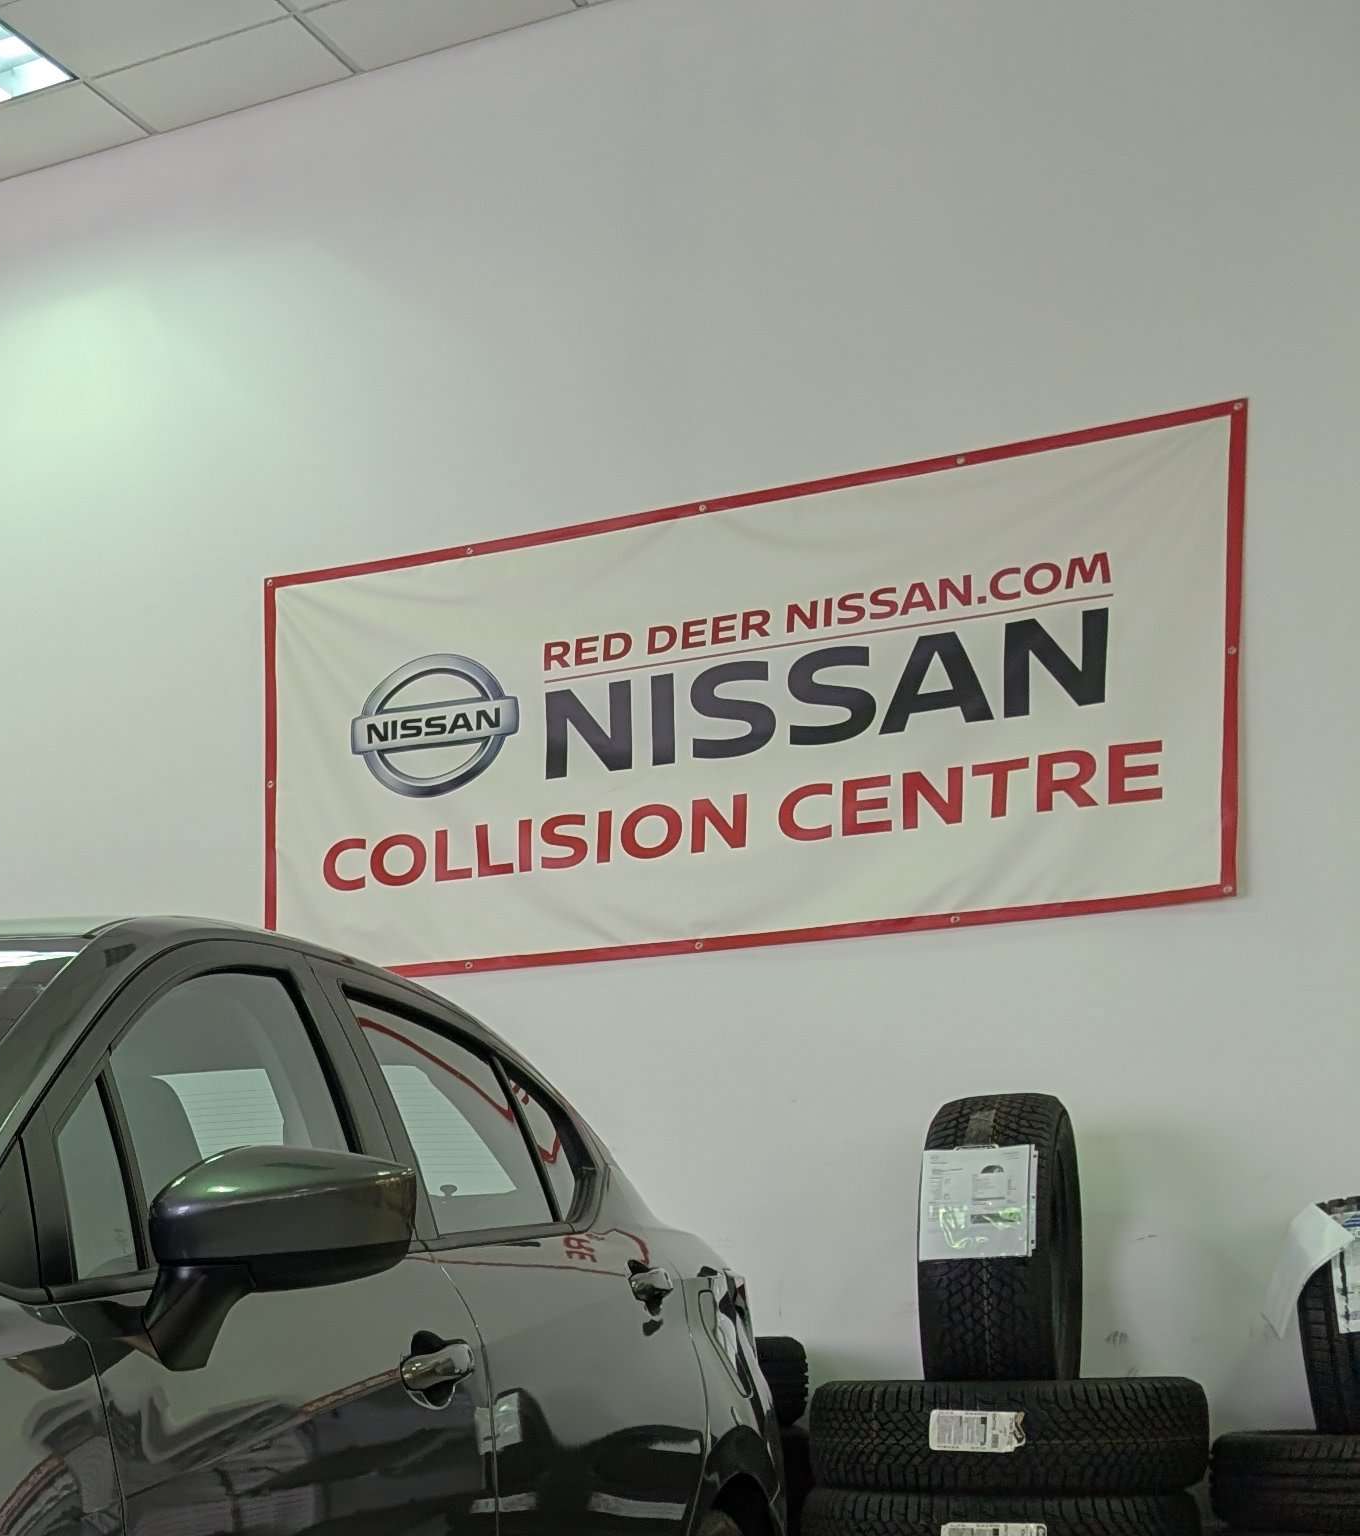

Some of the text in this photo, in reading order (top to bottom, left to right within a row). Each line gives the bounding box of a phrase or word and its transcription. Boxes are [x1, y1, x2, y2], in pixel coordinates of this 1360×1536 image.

[543, 552, 1111, 670] RED DEER NISSAN.COM
[367, 707, 501, 745] NISSAN
[545, 607, 1109, 780] NISSAN
[322, 739, 1164, 892] COLLISION CENTRE
